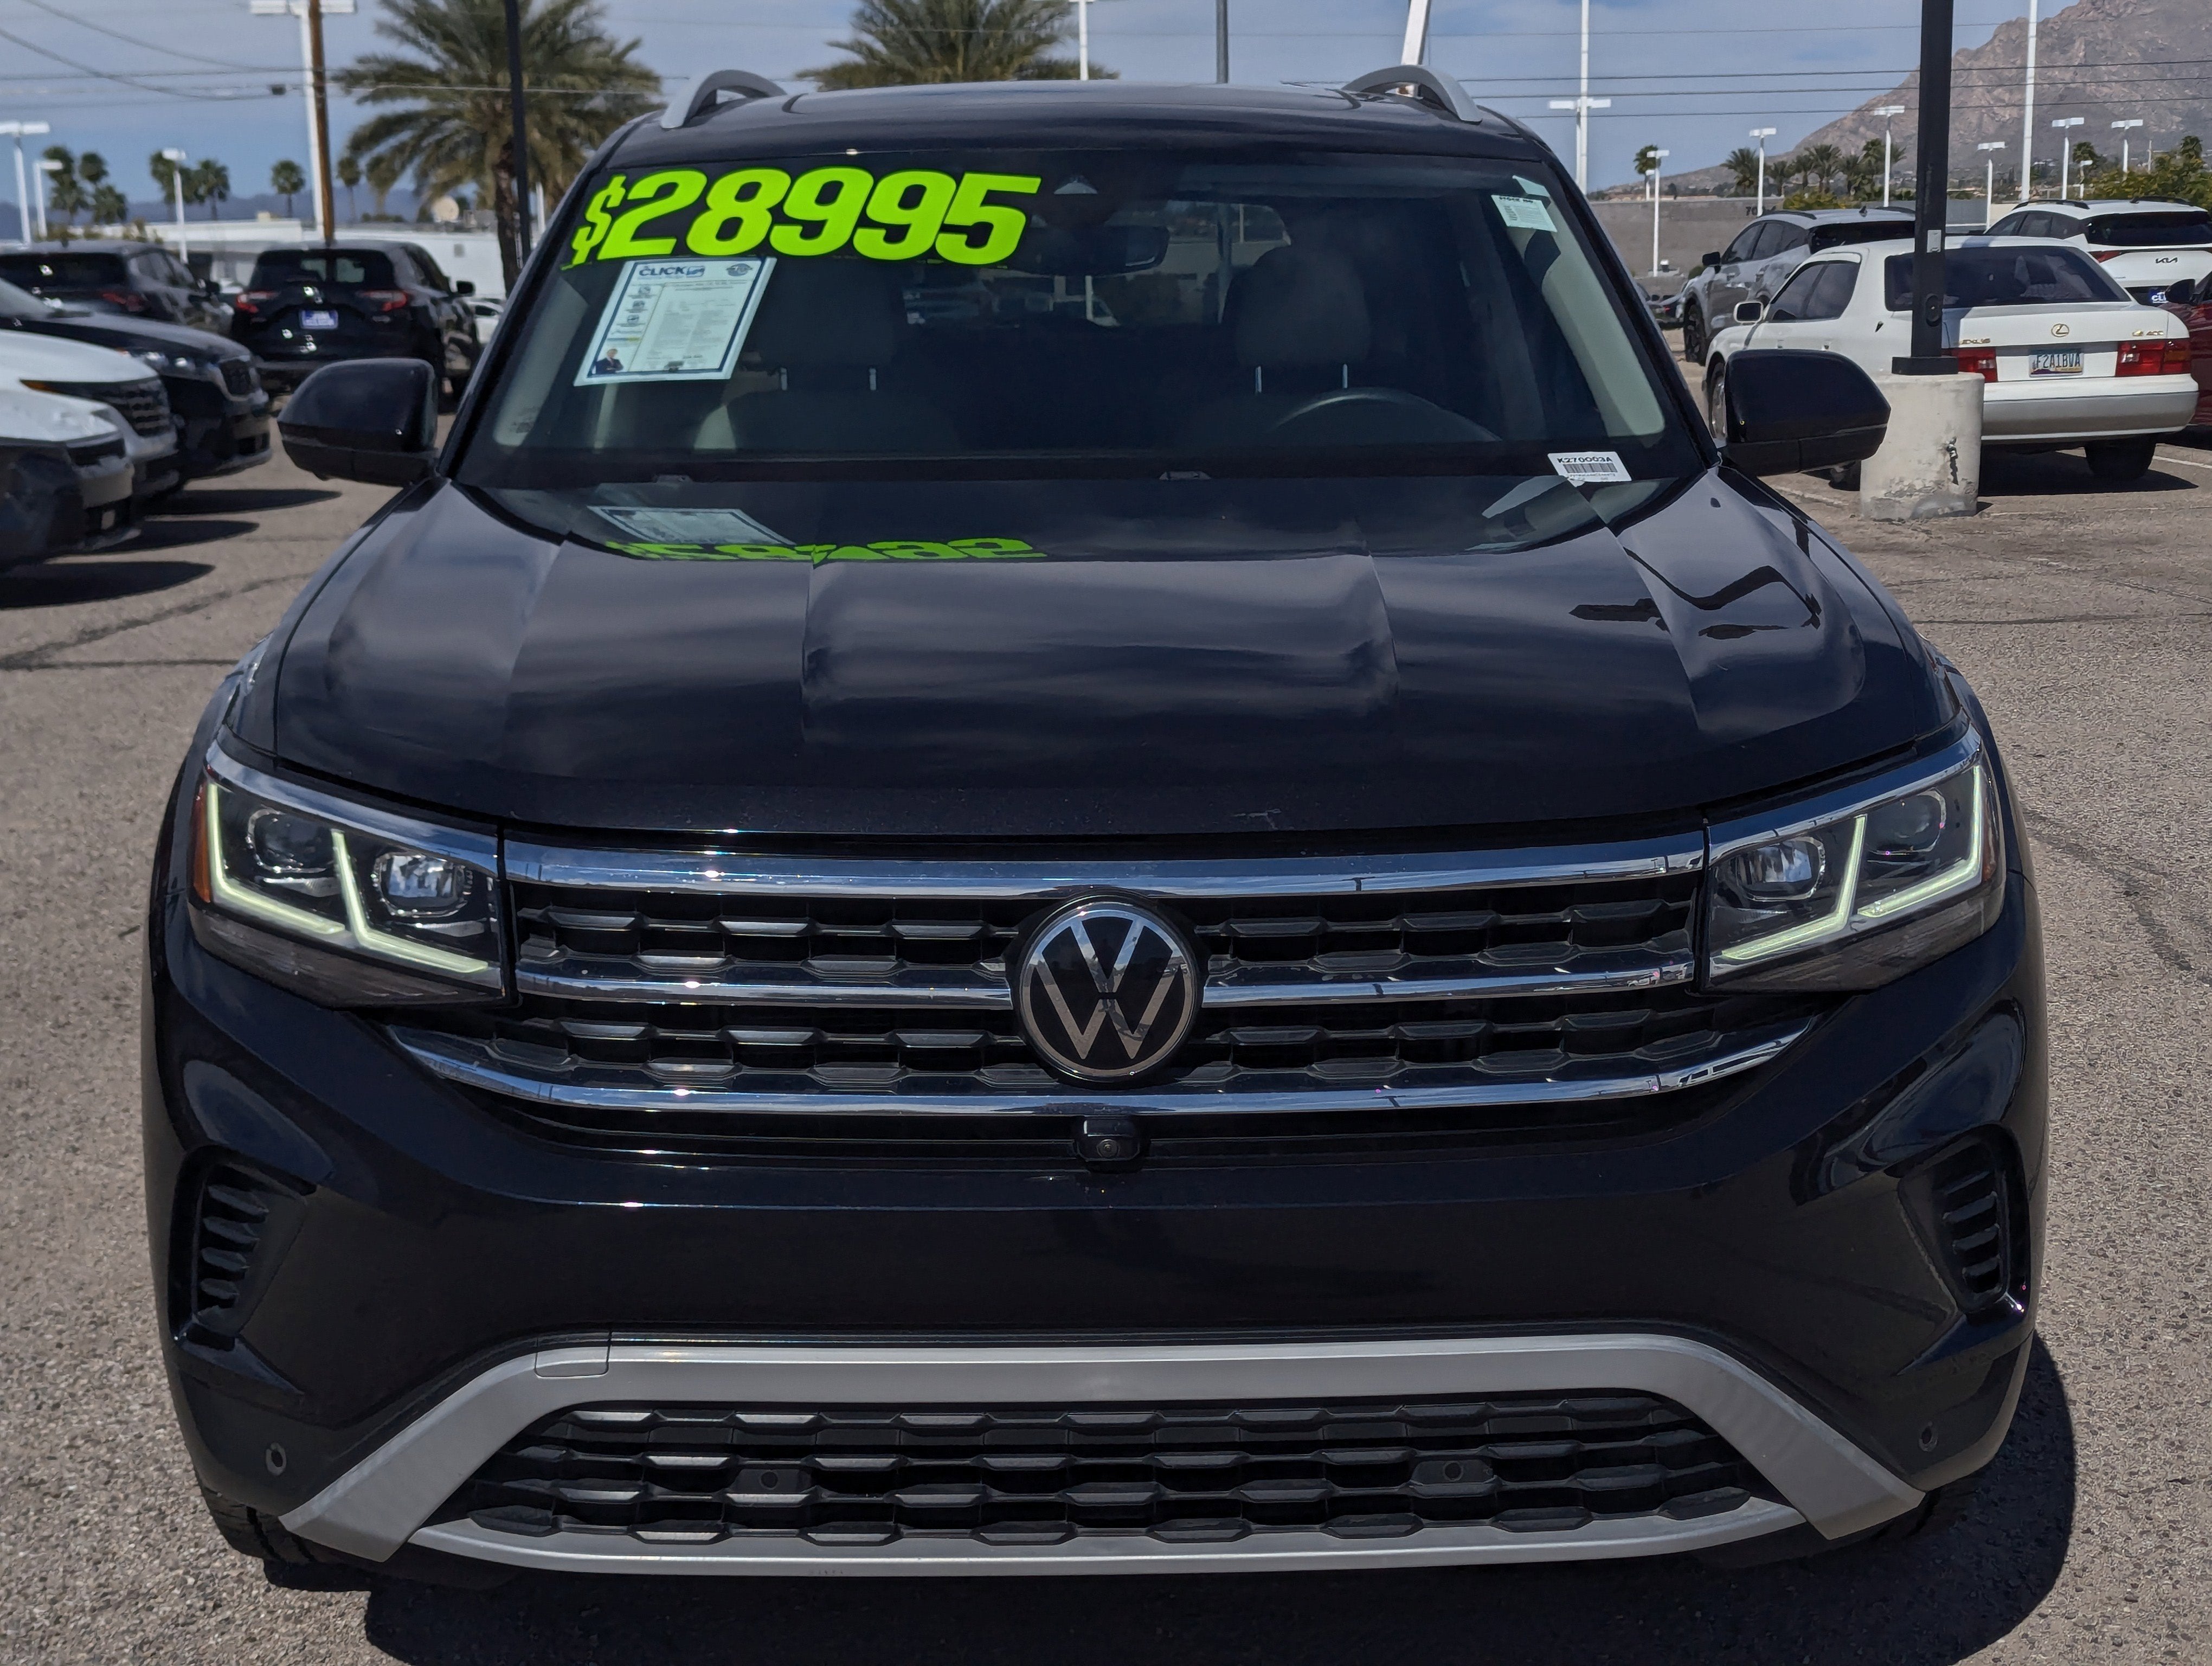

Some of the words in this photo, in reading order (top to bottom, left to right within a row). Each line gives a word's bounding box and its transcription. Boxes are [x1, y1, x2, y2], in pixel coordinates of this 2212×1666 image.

[562, 166, 1042, 270] $28995
[639, 266, 686, 276] CLICK
[1026, 905, 1194, 1073] VW
